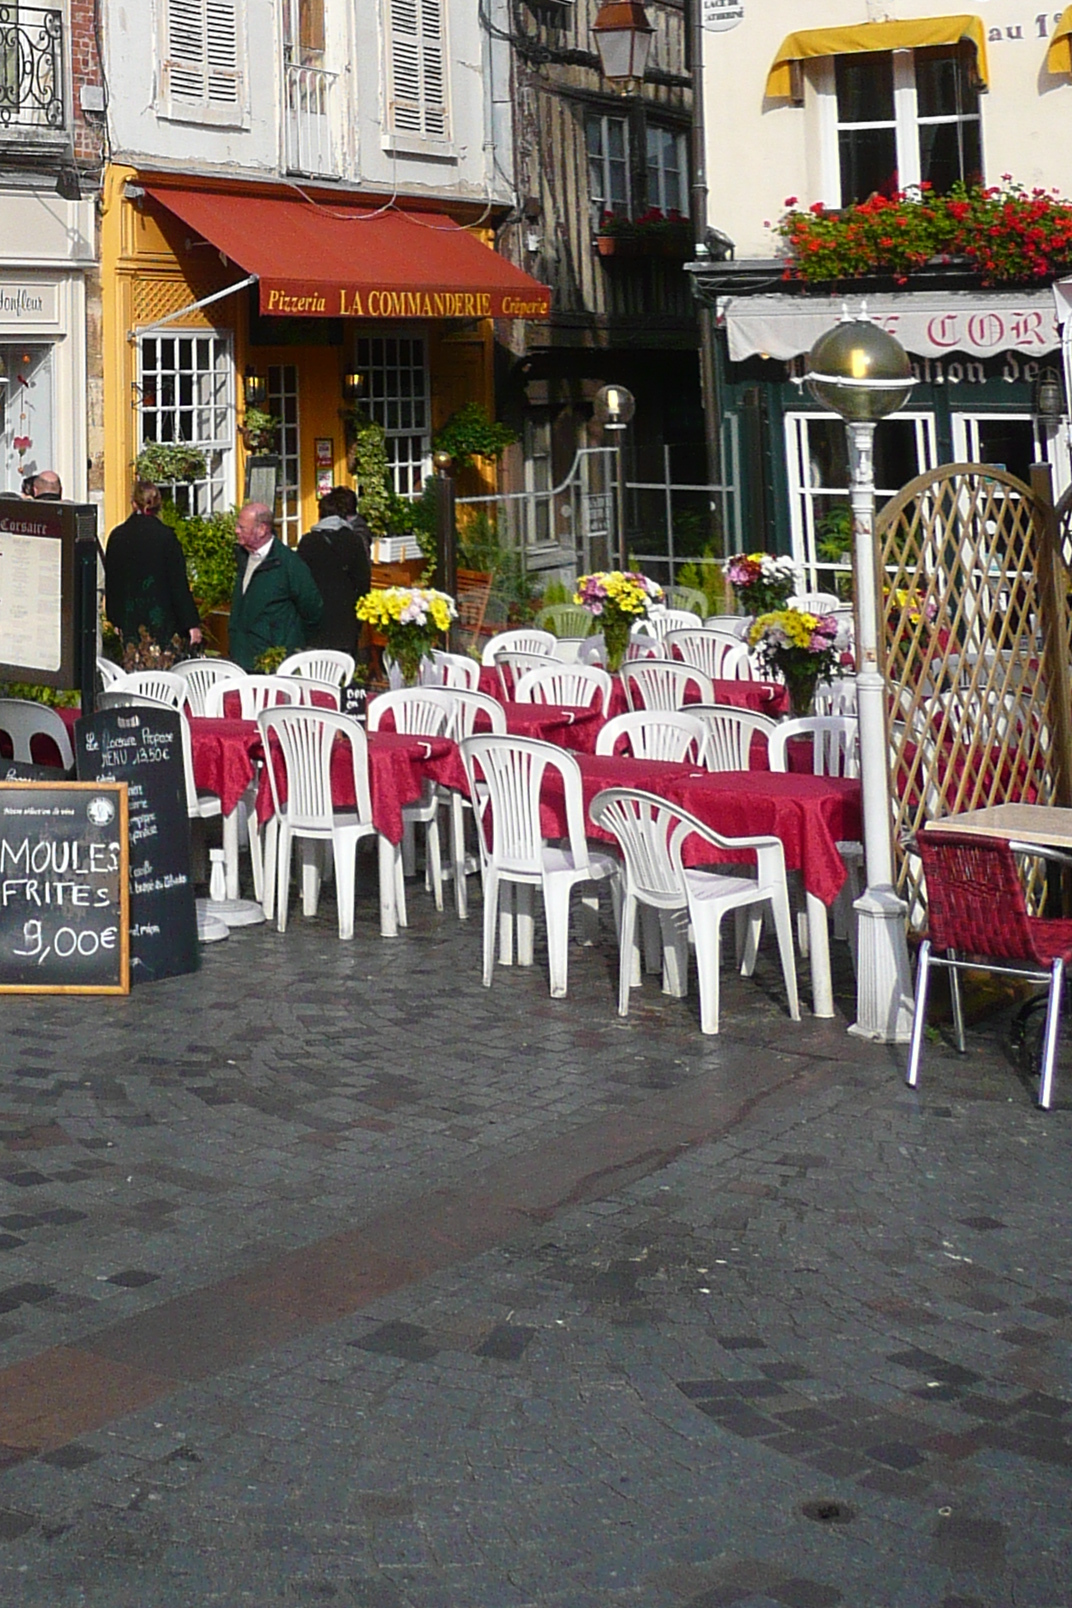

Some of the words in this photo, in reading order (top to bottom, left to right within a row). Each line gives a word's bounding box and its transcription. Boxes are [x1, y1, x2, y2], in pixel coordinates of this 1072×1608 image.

[988, 25, 1024, 42] au
[267, 290, 325, 312] Pizzeria
[339, 289, 364, 315] LA
[368, 291, 491, 317] COMMANDERIE
[501, 296, 547, 314] Crêperie
[0, 518, 47, 535] Corsaire
[142, 727, 173, 745] Propose
[0, 838, 120, 874] MOULES
[2, 878, 110, 907] FRITES
[13, 919, 118, 965] 9,00€
